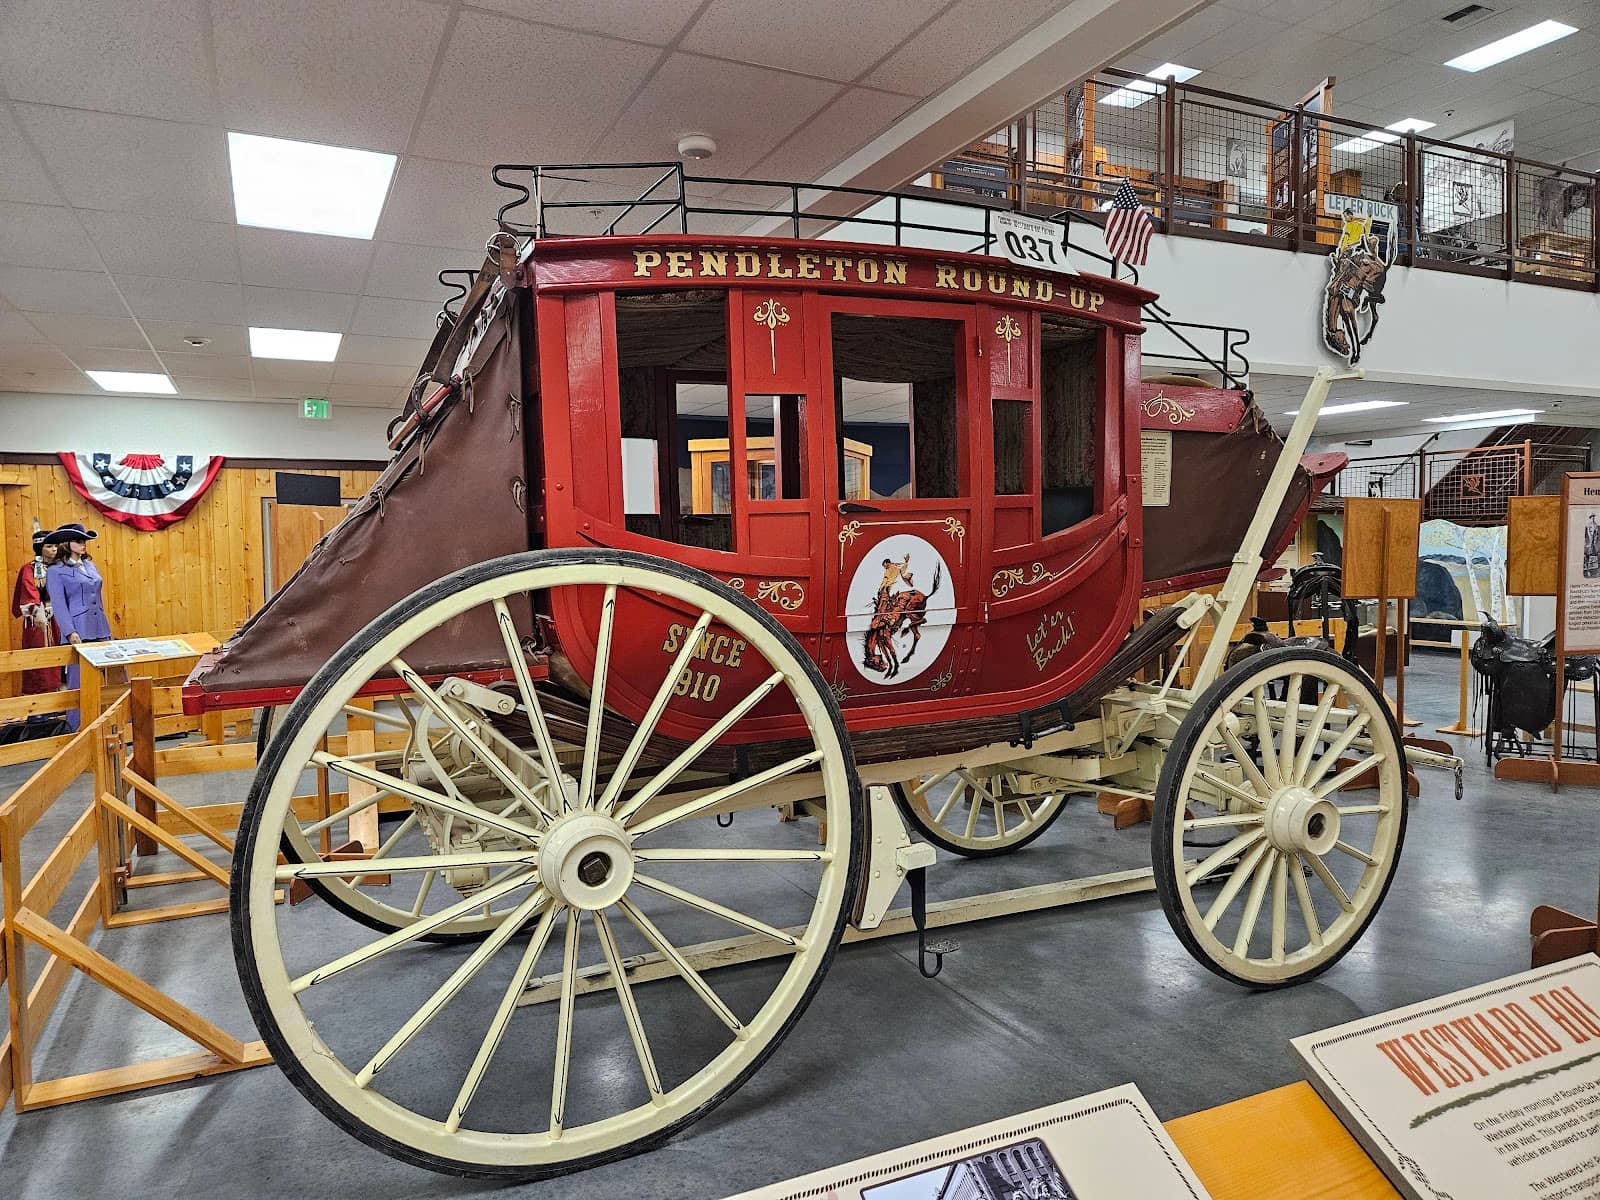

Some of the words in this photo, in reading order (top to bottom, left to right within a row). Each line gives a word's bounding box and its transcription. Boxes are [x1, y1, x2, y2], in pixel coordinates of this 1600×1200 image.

[1328, 193, 1348, 211] LET
[1350, 198, 1364, 215] ER
[1367, 201, 1394, 220] BUCK
[1004, 230, 1058, 265] 037
[631, 249, 909, 286] PENDLETON
[935, 262, 1106, 313] ROUND-UP
[1033, 615, 1076, 672] Buck!
[669, 664, 721, 702] 910
[1375, 1002, 1563, 1097] WESTWARD
[1473, 1120, 1488, 1132] On
[1486, 1115, 1500, 1127] the
[1498, 1106, 1524, 1122] Friday
[1523, 1096, 1555, 1113] morning
[1552, 1091, 1562, 1102] of
[1559, 1081, 1595, 1099] Round-Up
[1483, 1123, 1522, 1143] Westward
[1534, 1109, 1561, 1123] Parade
[1559, 1102, 1578, 1116] pays
[1575, 1094, 1599, 1108] tribute
[1503, 1140, 1520, 1152] the
[1538, 1126, 1556, 1138] This
[1555, 1117, 1580, 1133] parade
[1577, 1114, 1587, 1123] is
[1507, 1150, 1539, 1167] vehicles
[1537, 1144, 1552, 1156] are
[1550, 1133, 1579, 1151] allowed
[1577, 1130, 1588, 1140] to
[1528, 1180, 1547, 1192] The
[1544, 1163, 1583, 1186] Westward
